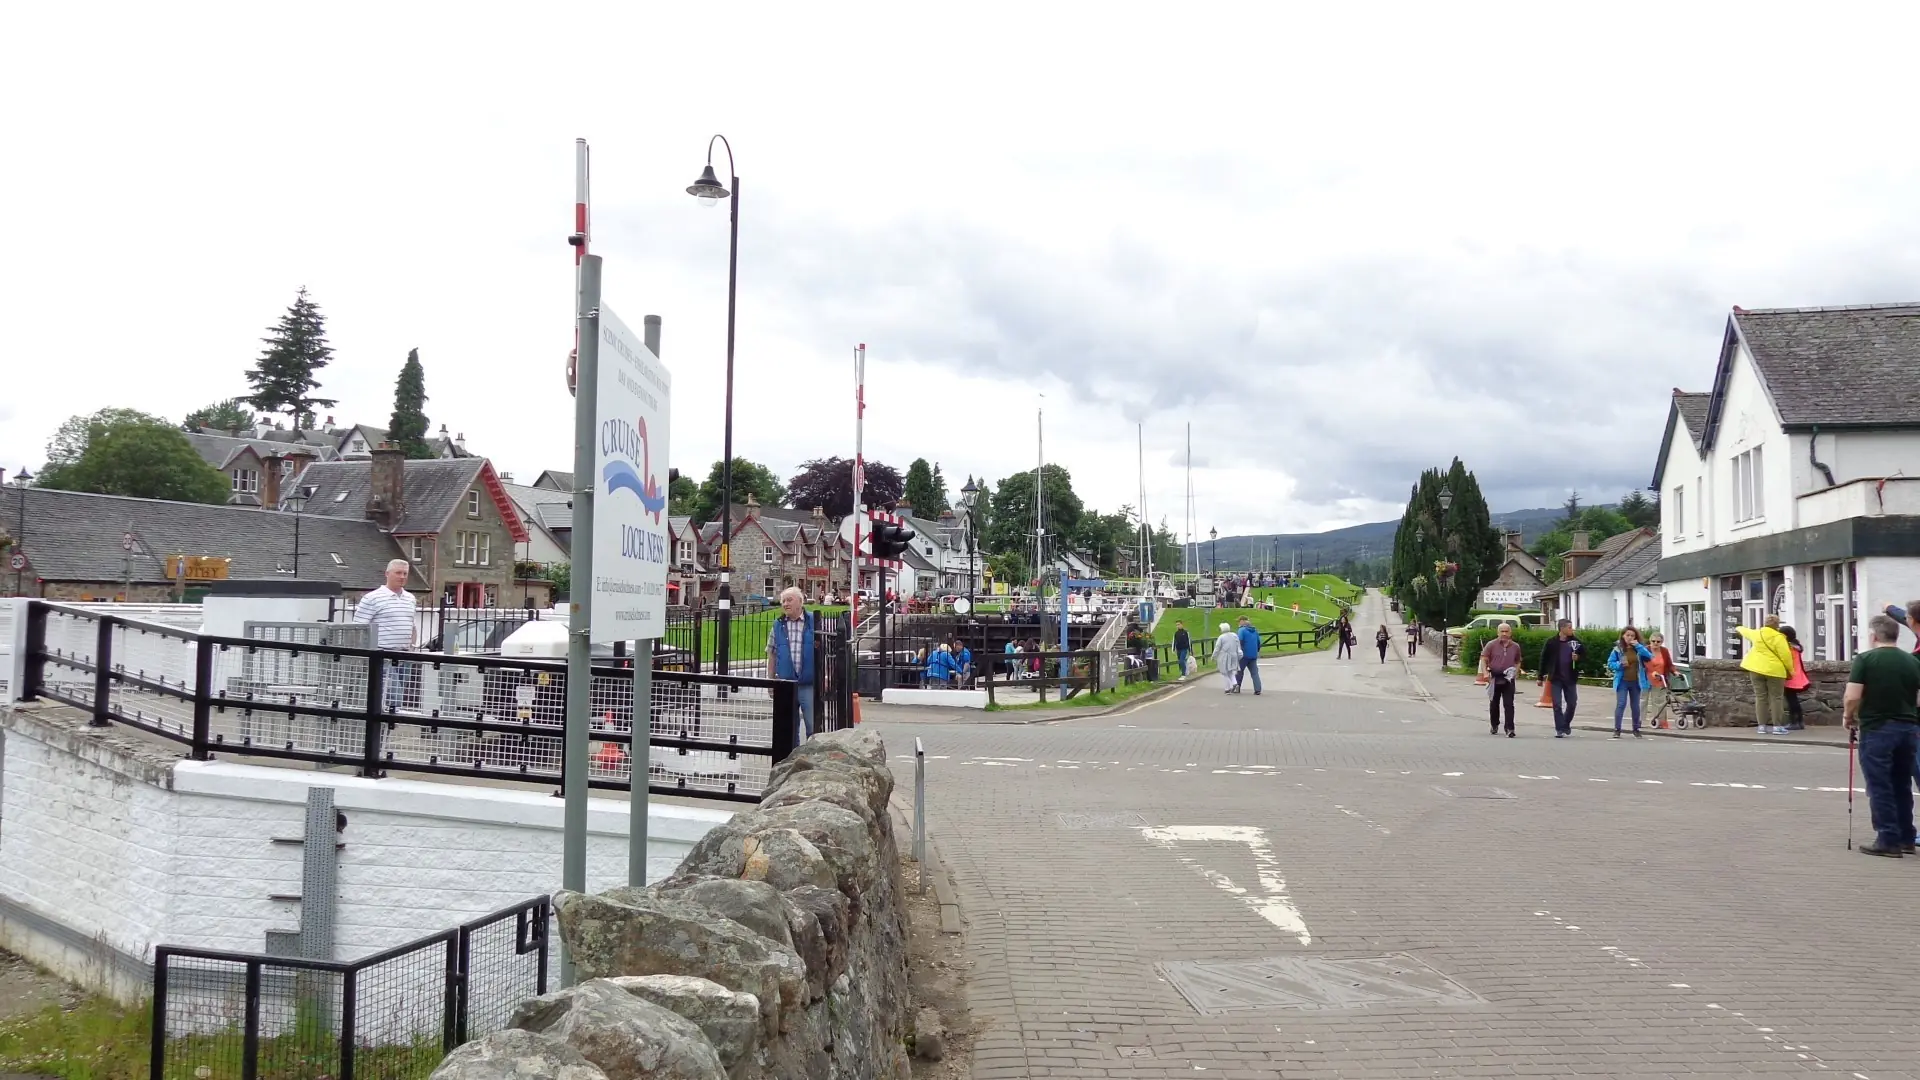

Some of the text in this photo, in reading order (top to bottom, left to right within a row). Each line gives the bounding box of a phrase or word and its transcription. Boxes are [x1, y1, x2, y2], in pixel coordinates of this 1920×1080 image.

[602, 418, 641, 469] CRUISE
[12, 557, 24, 566] 20
[621, 524, 664, 565] LOCH NESS
